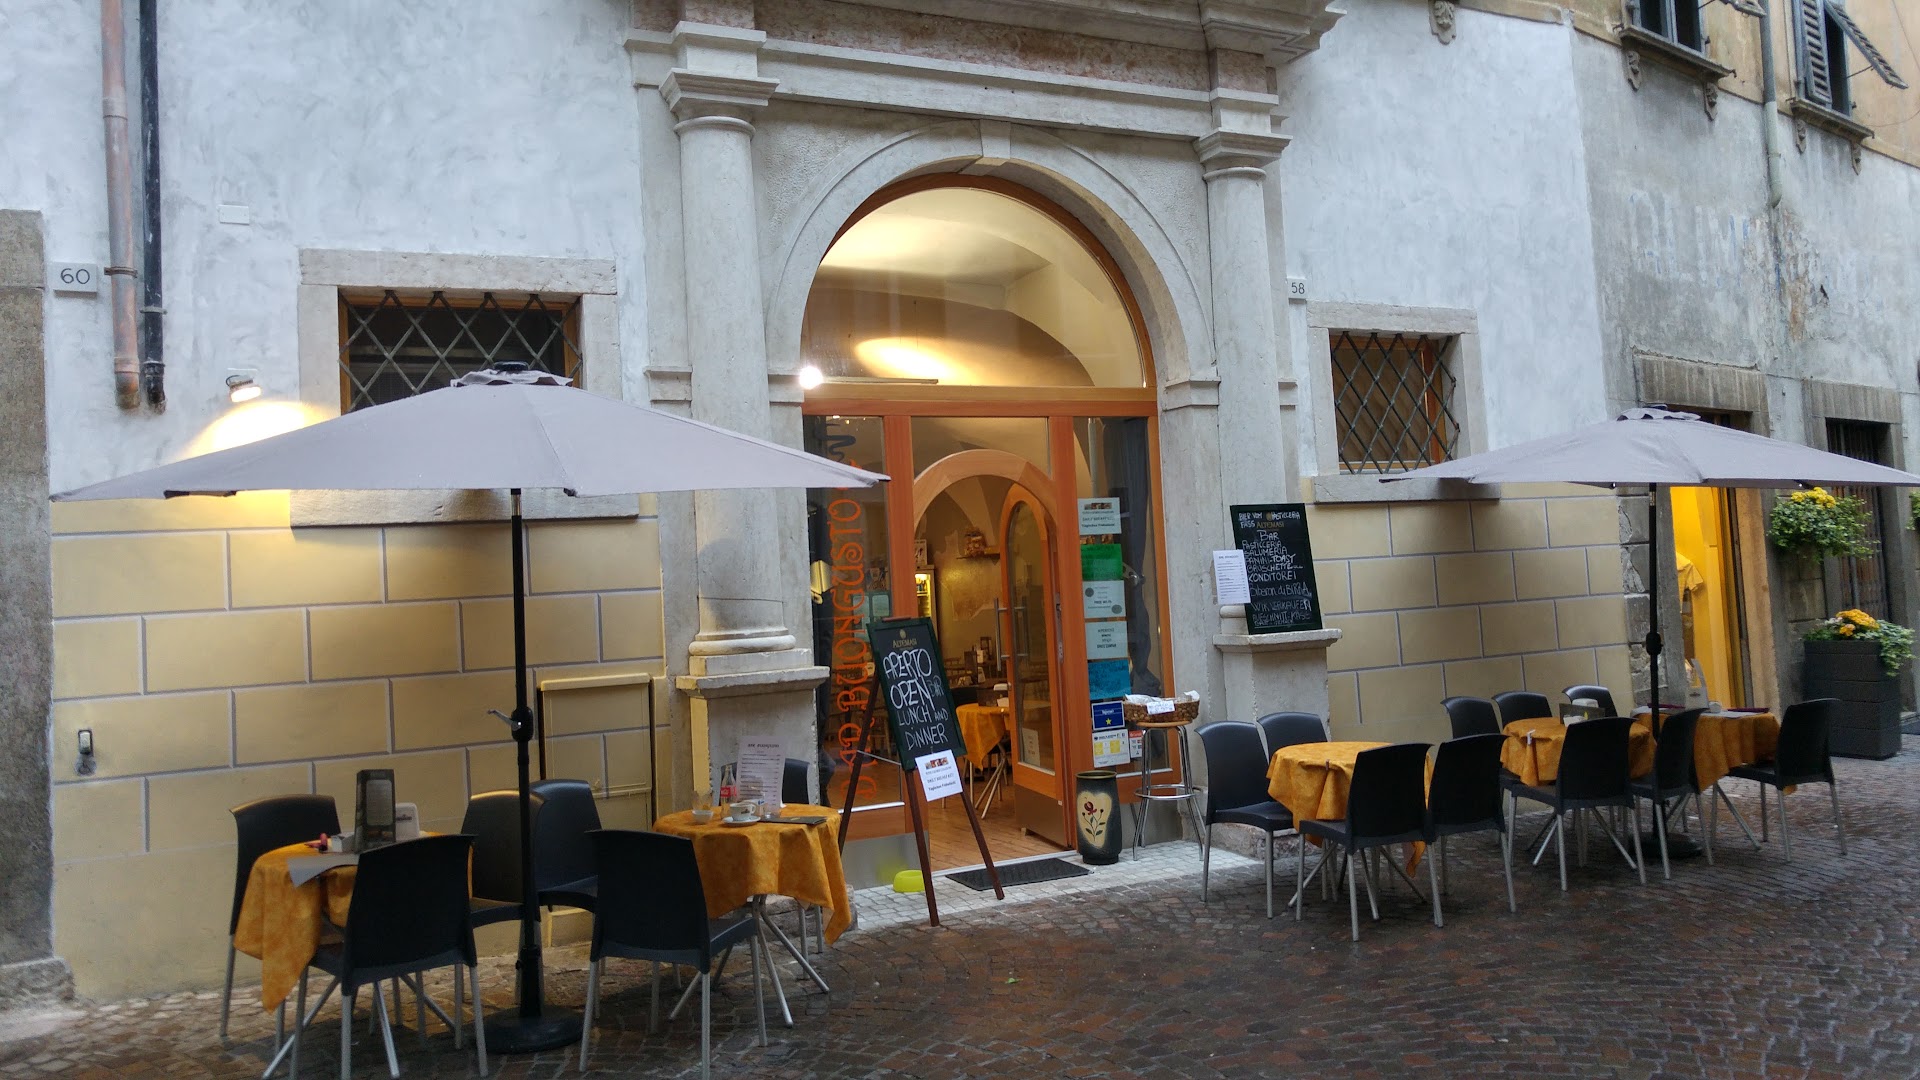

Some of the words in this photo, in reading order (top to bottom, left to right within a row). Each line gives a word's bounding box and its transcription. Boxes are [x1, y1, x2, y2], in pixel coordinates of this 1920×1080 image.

[60, 267, 91, 285] 60
[1291, 281, 1306, 295] 58
[827, 499, 872, 712] BUONGUSTO
[882, 648, 932, 680] APERTO
[889, 676, 936, 711] OPEN
[896, 704, 932, 726] LUNCH
